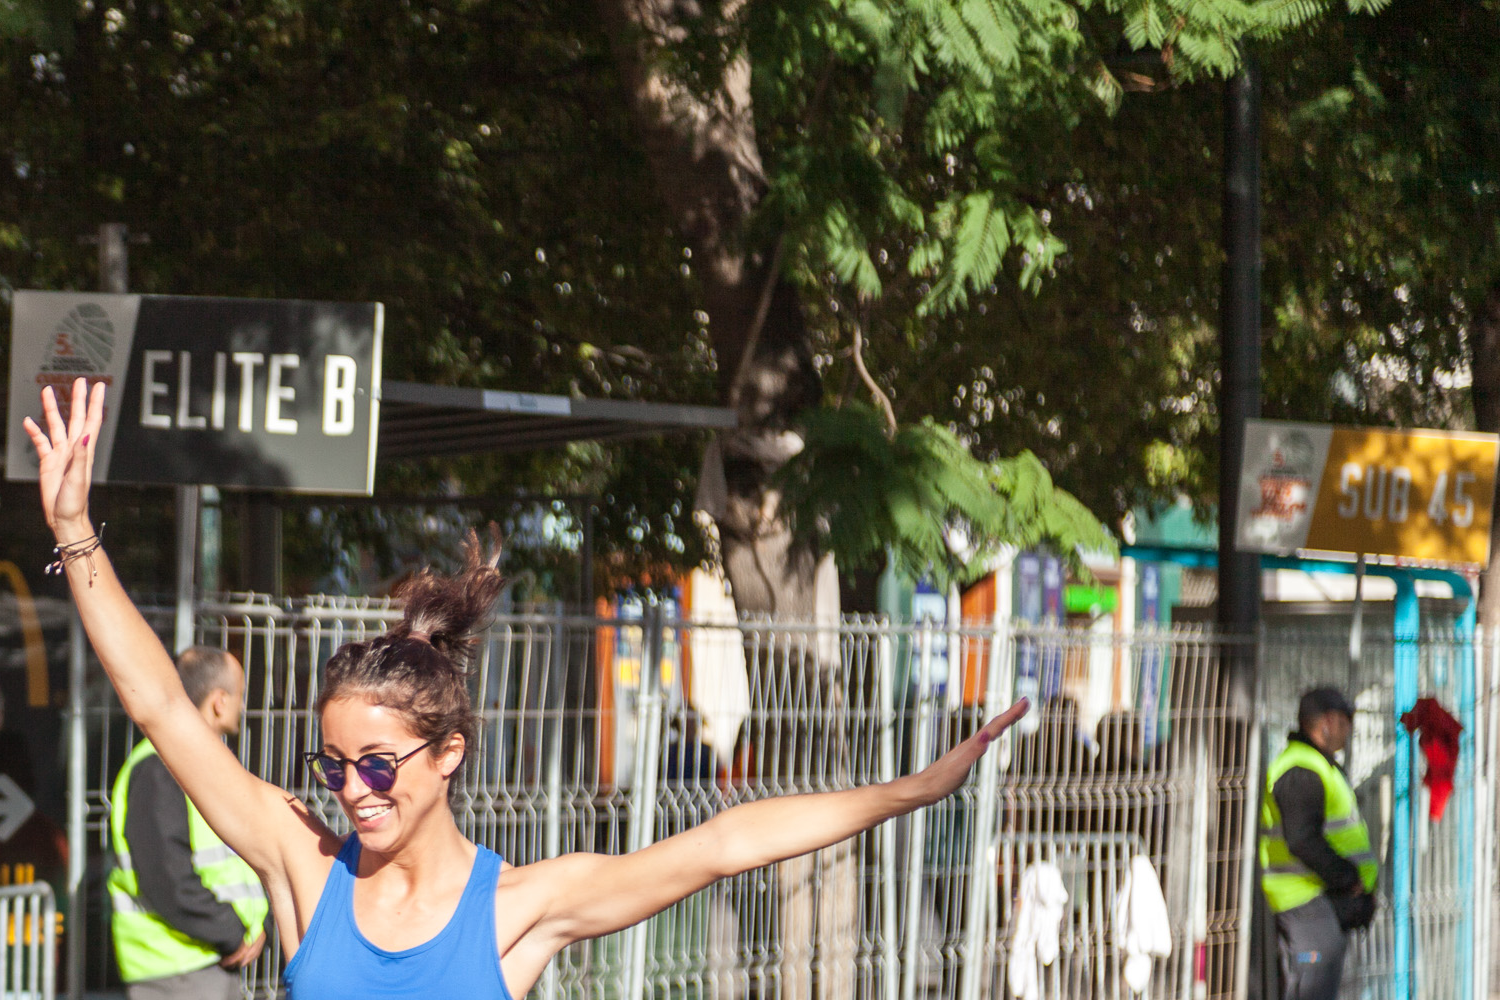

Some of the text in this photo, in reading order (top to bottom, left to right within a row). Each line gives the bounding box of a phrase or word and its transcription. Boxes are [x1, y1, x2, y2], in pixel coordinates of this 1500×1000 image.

[140, 350, 300, 435] ELITE
[322, 353, 358, 436] B
[1338, 462, 1413, 523] SUB
[1427, 470, 1477, 528] 45
